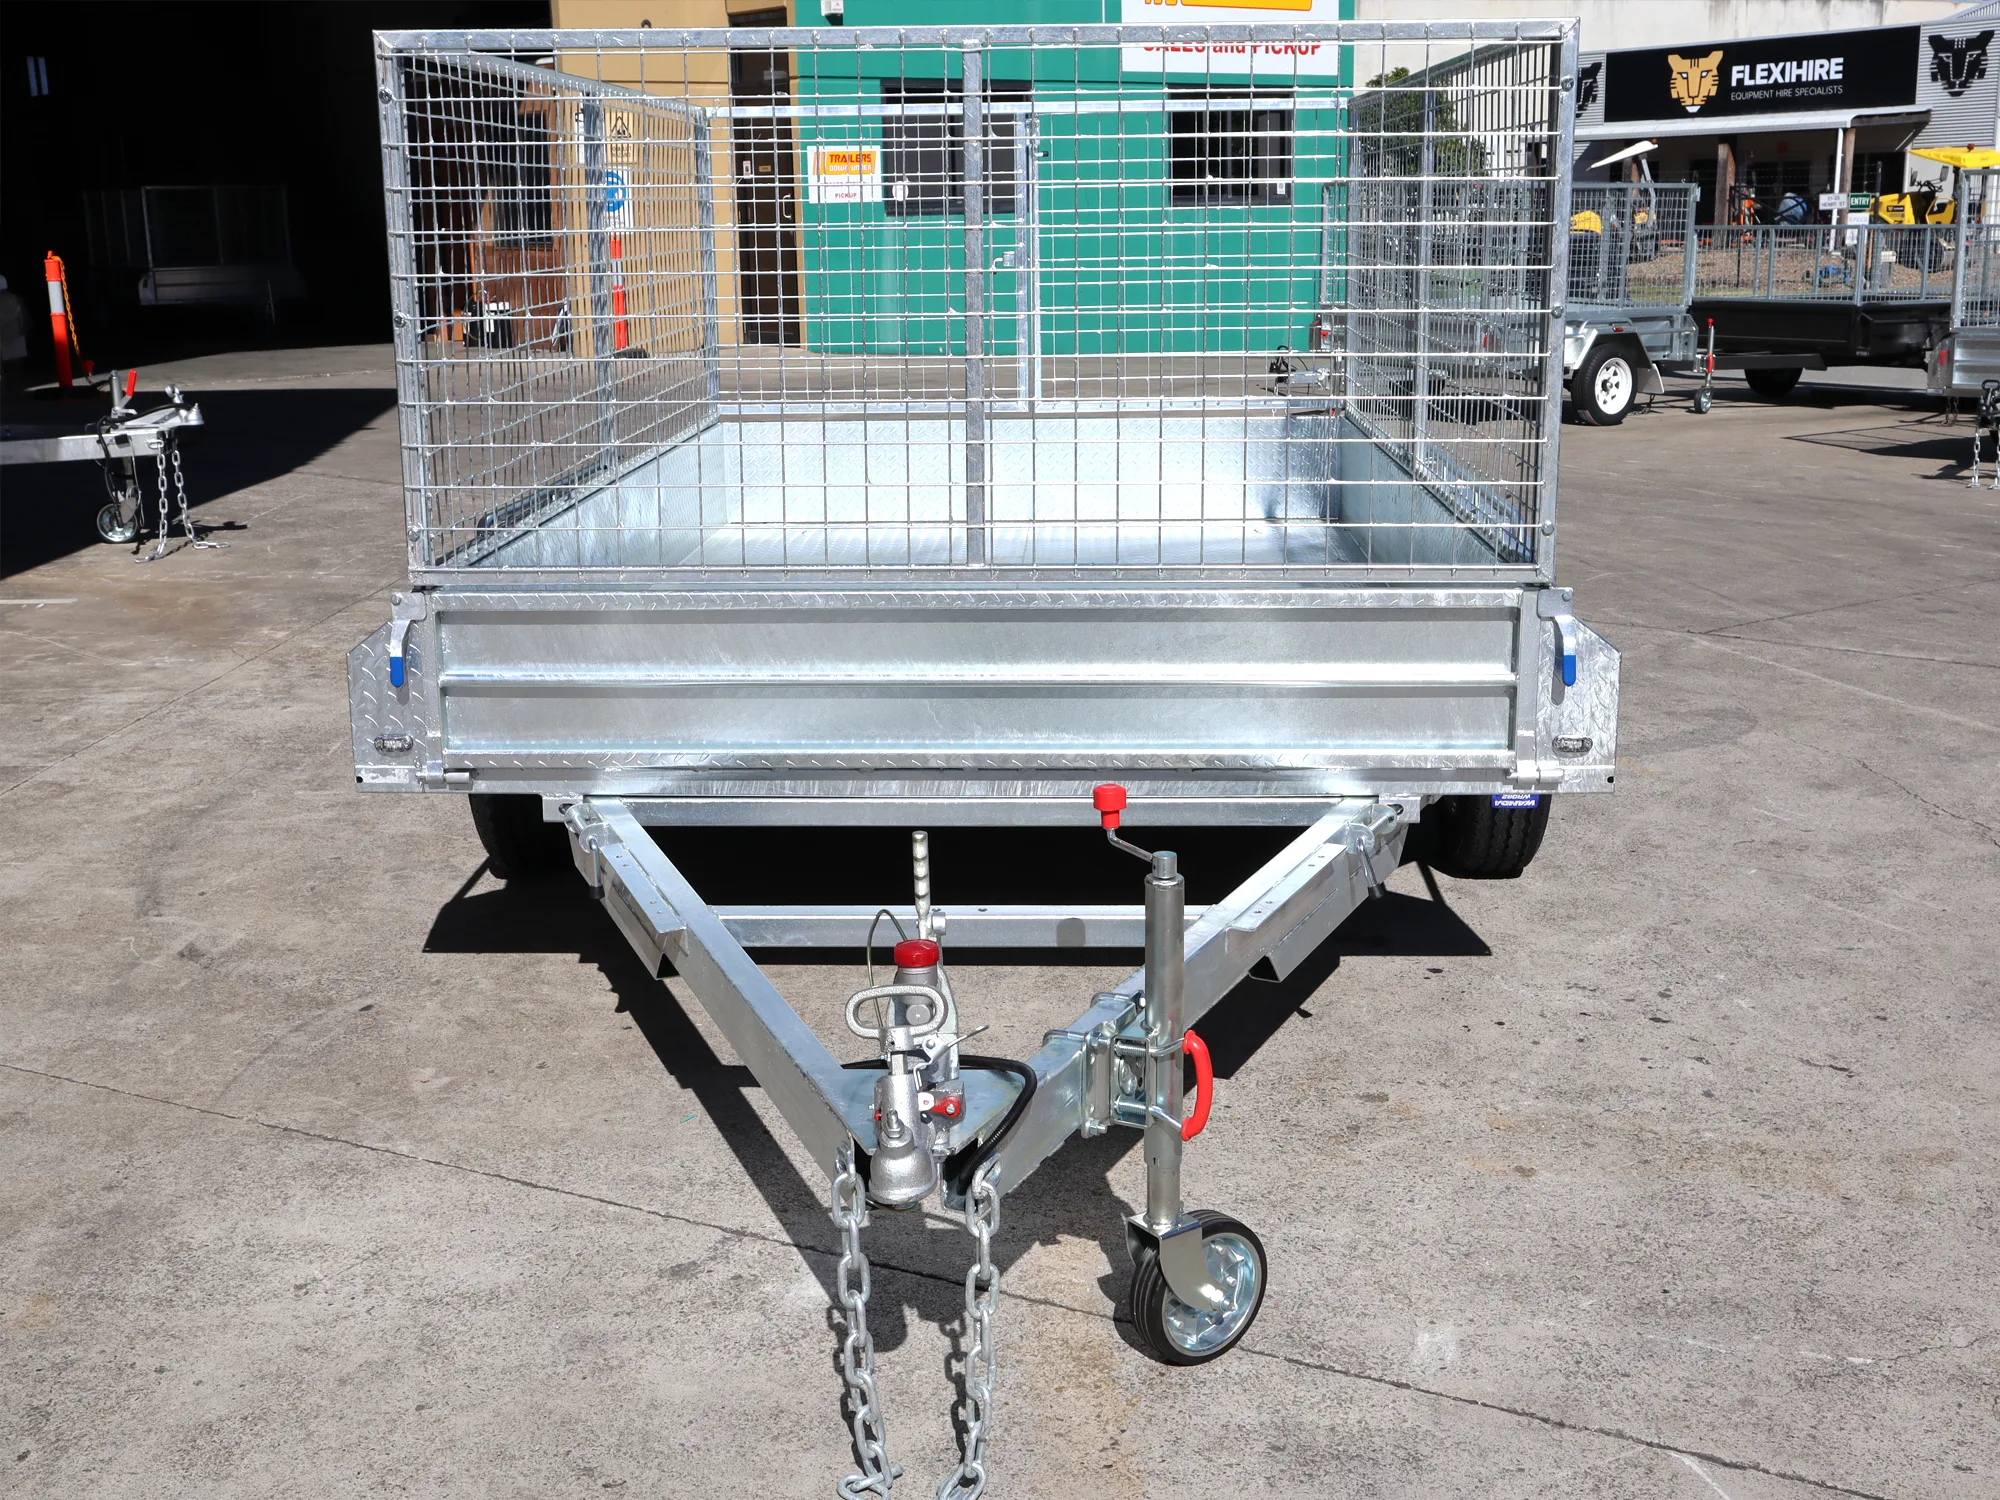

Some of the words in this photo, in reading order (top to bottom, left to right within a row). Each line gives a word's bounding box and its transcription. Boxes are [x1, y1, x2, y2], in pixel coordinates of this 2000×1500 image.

[1731, 57, 1844, 87] FLEXIHIRE
[1730, 89, 1774, 101] EQUIPMENT
[1775, 88, 1793, 98] HIRE
[1794, 84, 1844, 97] SPECIALISTS
[829, 153, 872, 163] TRAILERS
[1850, 197, 1870, 206] ENTRY
[1494, 799, 1536, 807] WANDA
